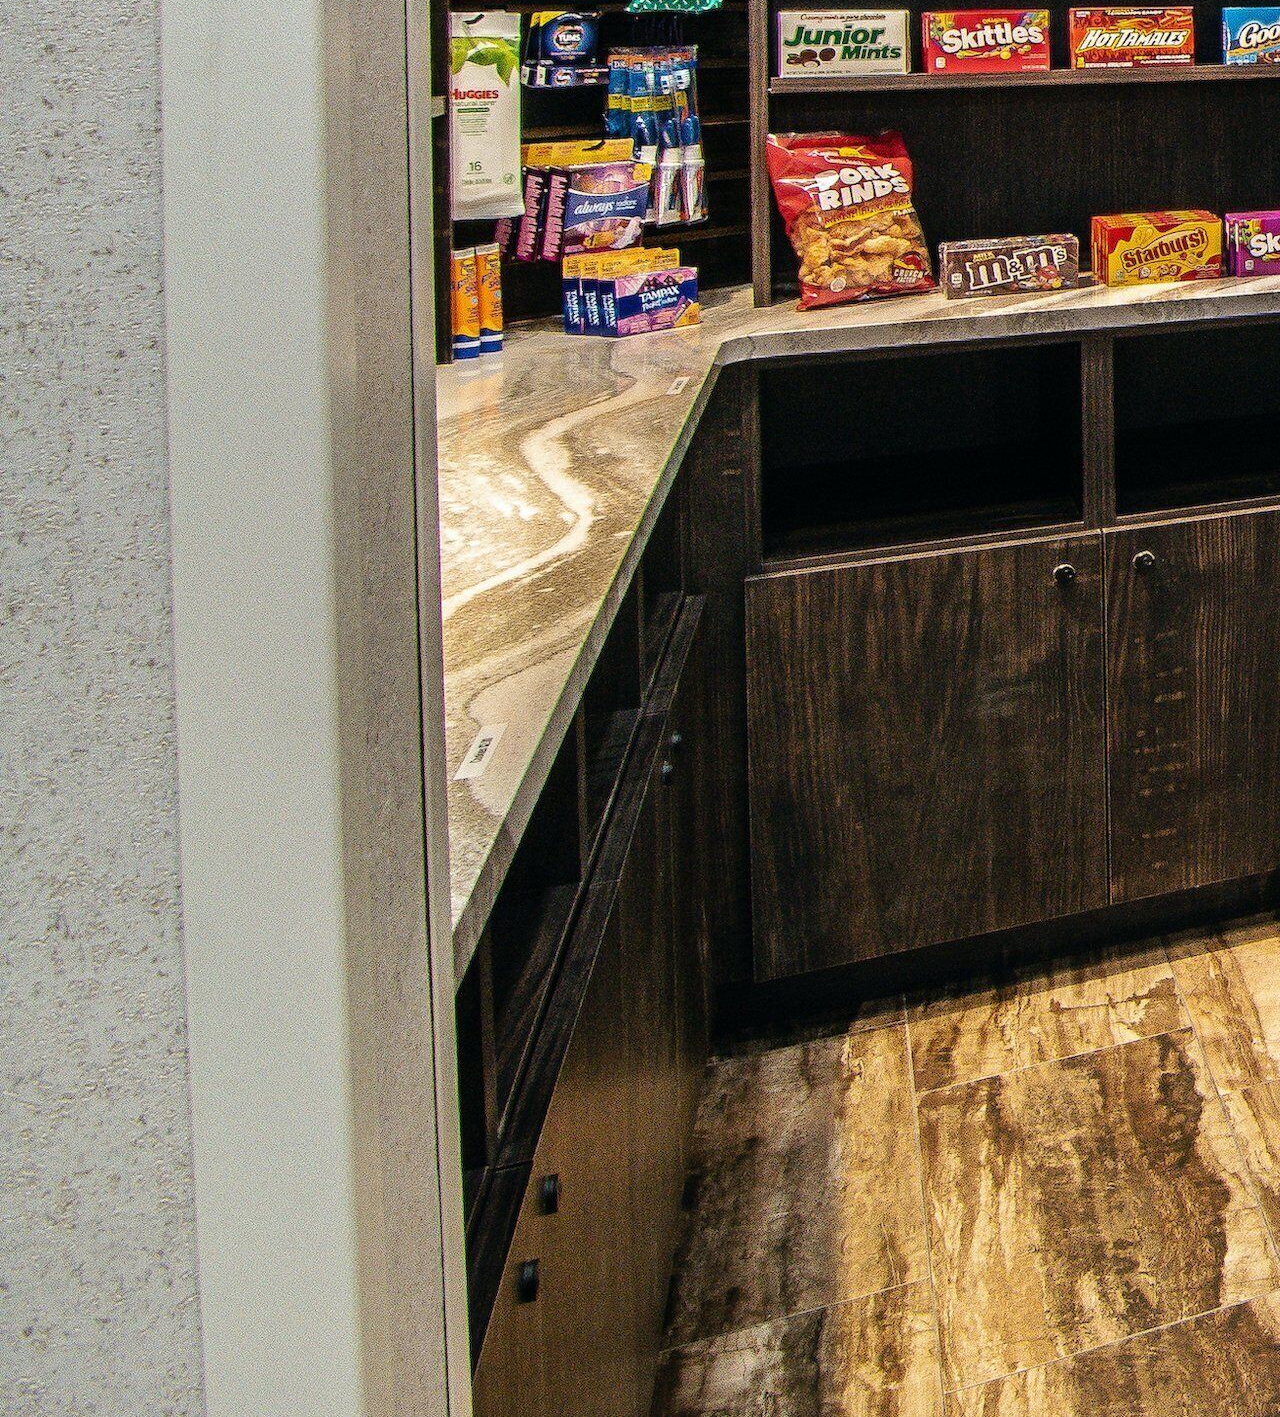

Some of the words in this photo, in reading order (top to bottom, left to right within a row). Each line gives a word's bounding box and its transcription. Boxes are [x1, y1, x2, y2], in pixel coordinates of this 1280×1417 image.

[558, 33, 581, 43] TUMS
[784, 24, 885, 46] Junior
[941, 24, 1045, 54] Skittles
[1080, 30, 1120, 50] HOT
[1116, 29, 1187, 48] TAMALES
[841, 45, 901, 60] Mints
[451, 89, 499, 100] HUGGIES
[469, 161, 482, 172] 16
[814, 163, 900, 190] PORK
[819, 176, 910, 211] RINDS
[574, 199, 615, 215] always
[1124, 229, 1208, 270] Starburst
[967, 246, 1067, 289] m&m's
[638, 286, 679, 303] TAMPAX
